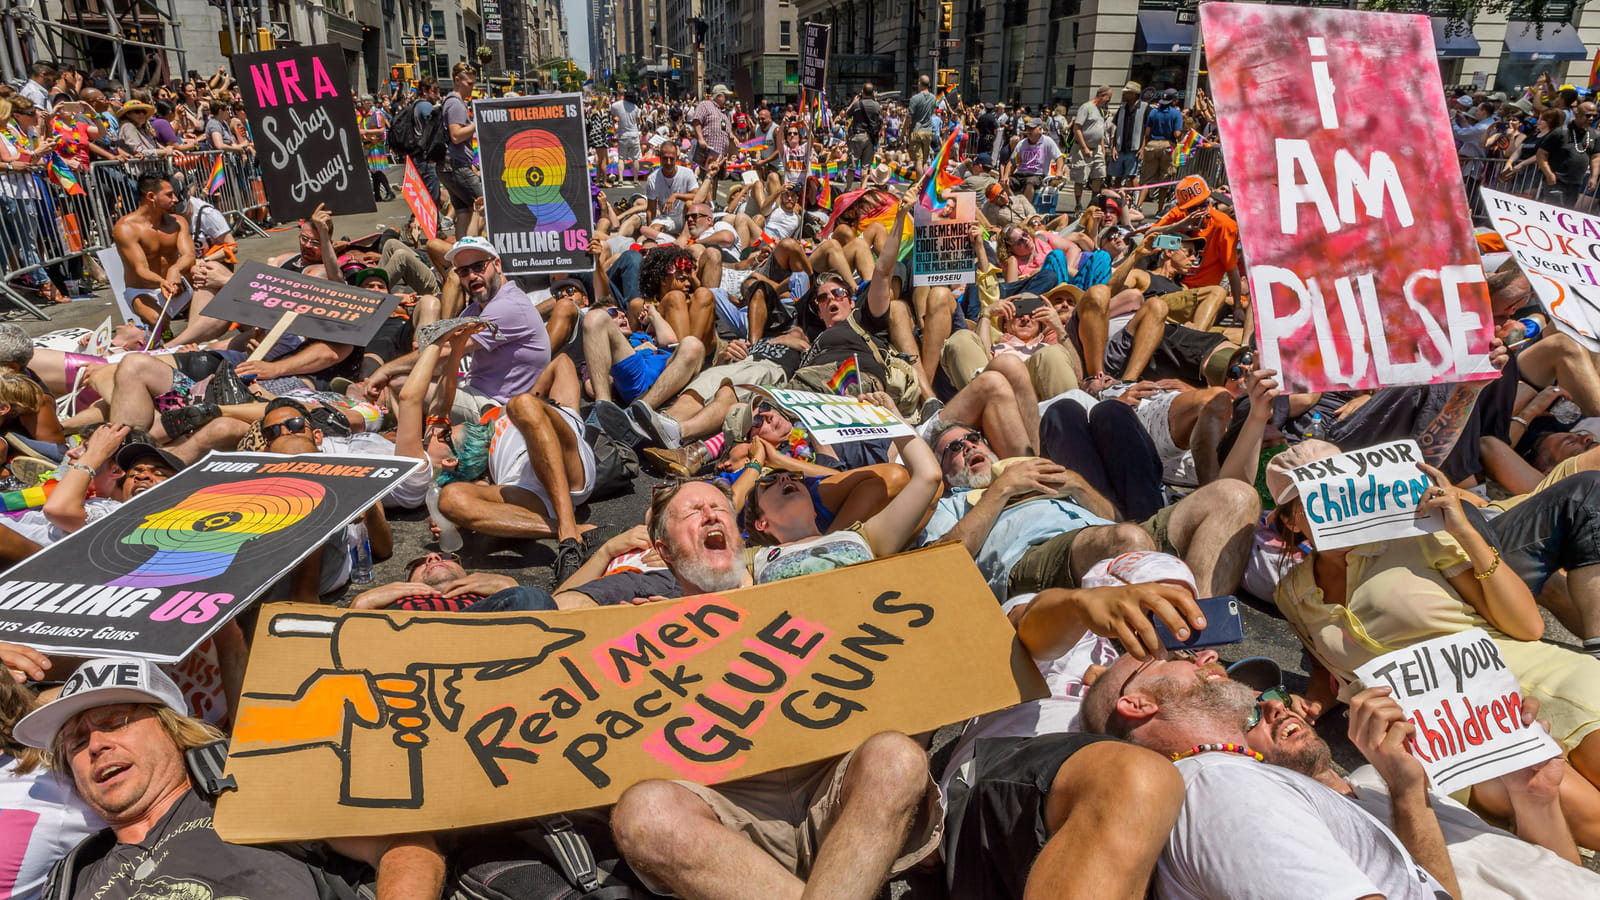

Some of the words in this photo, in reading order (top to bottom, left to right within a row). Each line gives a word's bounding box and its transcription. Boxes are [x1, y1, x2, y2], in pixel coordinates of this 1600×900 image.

[250, 56, 338, 108] NRA
[480, 109, 508, 123] YOUR
[508, 105, 565, 121] TOLERANCE
[566, 104, 578, 118] IS
[262, 105, 335, 170] Sashay
[291, 127, 354, 202] Away!
[1180, 183, 1202, 202] GAG
[1275, 138, 1414, 235] AM
[1493, 198, 1528, 216] IT'S
[1539, 210, 1550, 222] A
[493, 230, 561, 254] KILLING
[563, 228, 589, 252] US
[916, 227, 927, 238] WE
[916, 240, 938, 252] EDDIE
[1498, 217, 1585, 259] 20K
[916, 252, 932, 262] KILLED
[940, 251, 951, 261] JUNE
[921, 262, 931, 272] THE
[931, 261, 947, 271] PULSE
[255, 272, 382, 305] gaysagainstguns.net
[927, 274, 962, 282] 1199SEIU
[249, 281, 375, 314] GAYSAGAINSTGUNS
[250, 291, 361, 321] #gagonit
[1249, 263, 1500, 391] PULSE
[791, 403, 898, 427] NOW!
[836, 427, 889, 437] 1199SEIU
[200, 461, 260, 473] YOUR
[255, 462, 375, 478] TOLERANCE
[370, 466, 399, 479] IS
[1293, 458, 1347, 482] ASK
[0, 580, 162, 618] KILLING
[149, 590, 235, 625] US
[780, 591, 935, 730] GUNS
[464, 653, 600, 788] Real
[608, 603, 740, 682] Men
[662, 610, 829, 763] GLUE
